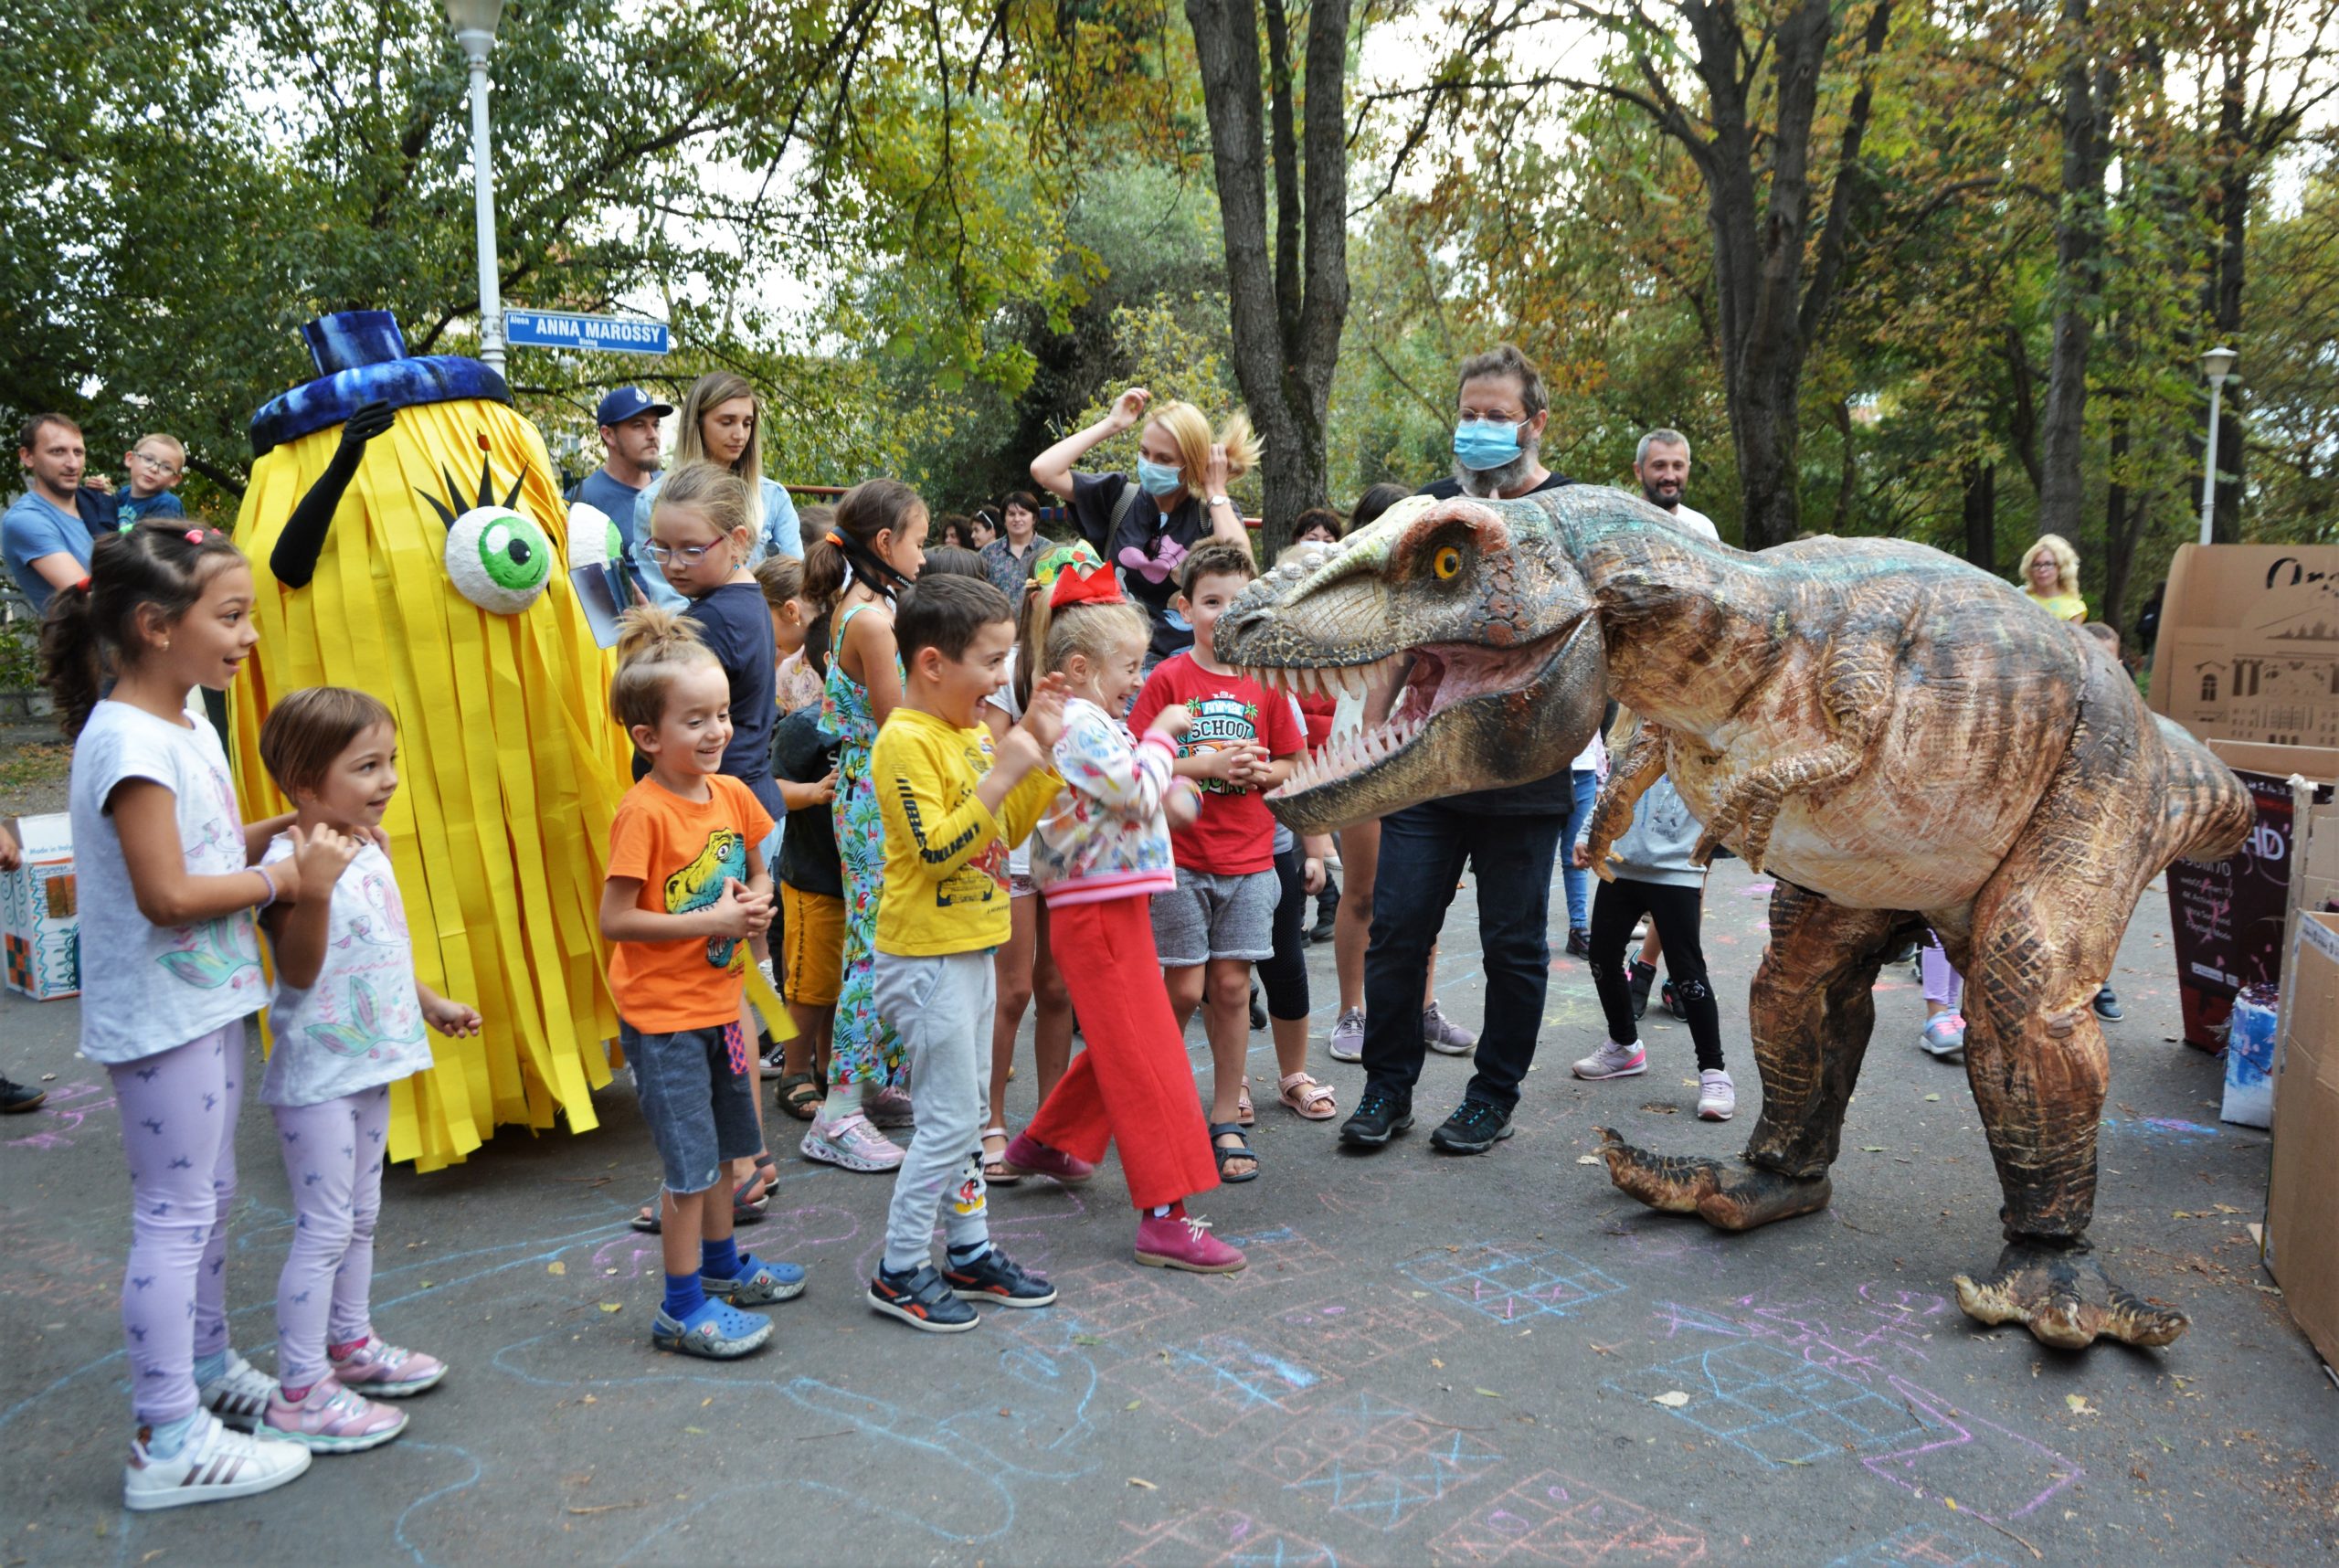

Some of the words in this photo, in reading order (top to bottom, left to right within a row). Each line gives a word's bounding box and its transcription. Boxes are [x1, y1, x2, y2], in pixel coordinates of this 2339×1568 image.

[536, 318, 580, 336] ANNA
[586, 323, 660, 343] MAROSSY
[895, 575, 911, 587] ONY
